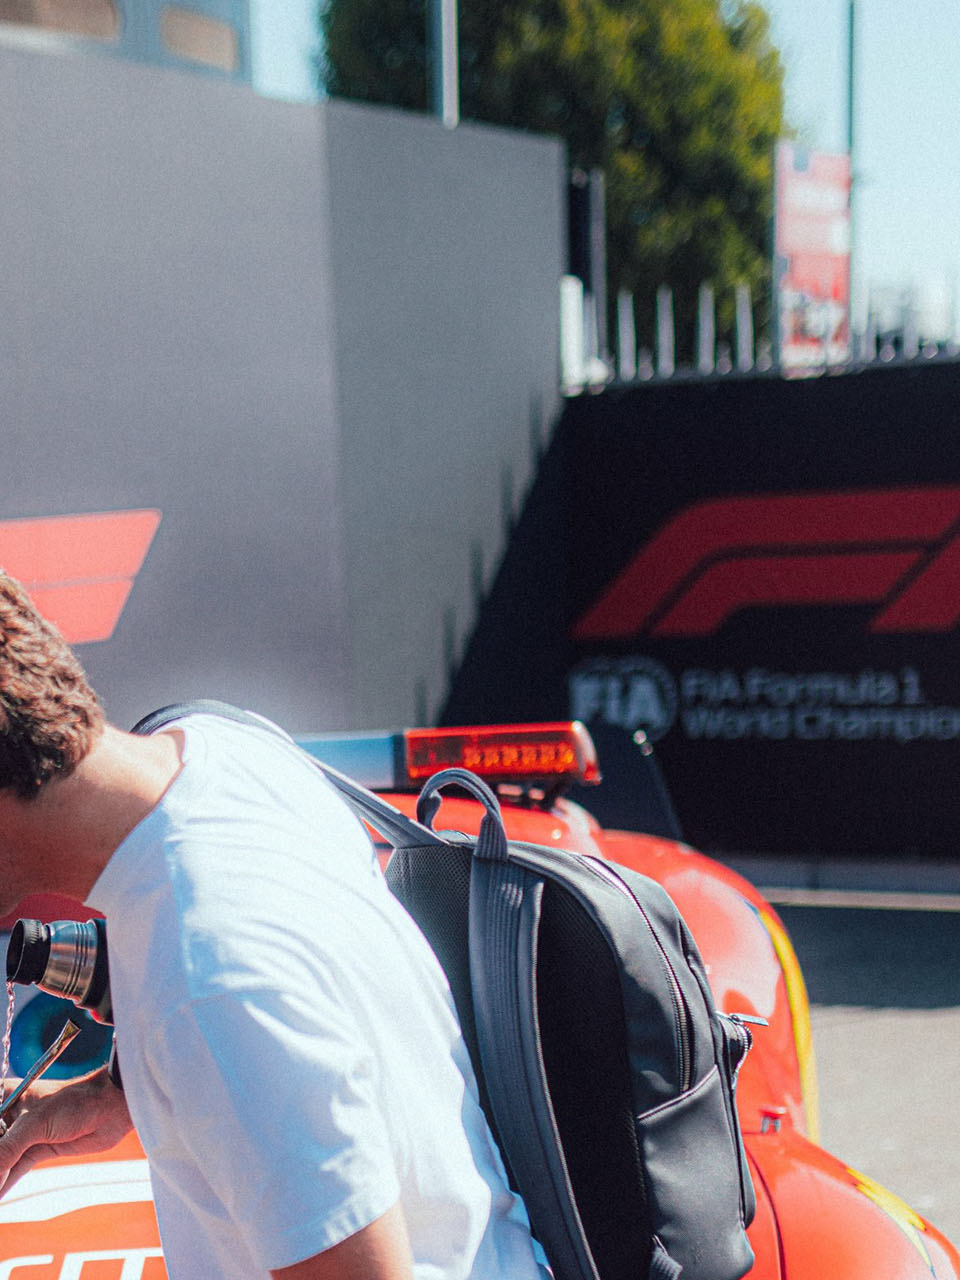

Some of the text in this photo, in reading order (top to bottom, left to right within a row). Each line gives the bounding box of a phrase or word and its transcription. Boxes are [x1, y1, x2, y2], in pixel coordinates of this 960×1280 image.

[570, 673, 664, 730] FIA
[682, 666, 922, 706] FIA Formula 1
[682, 706, 789, 739] World
